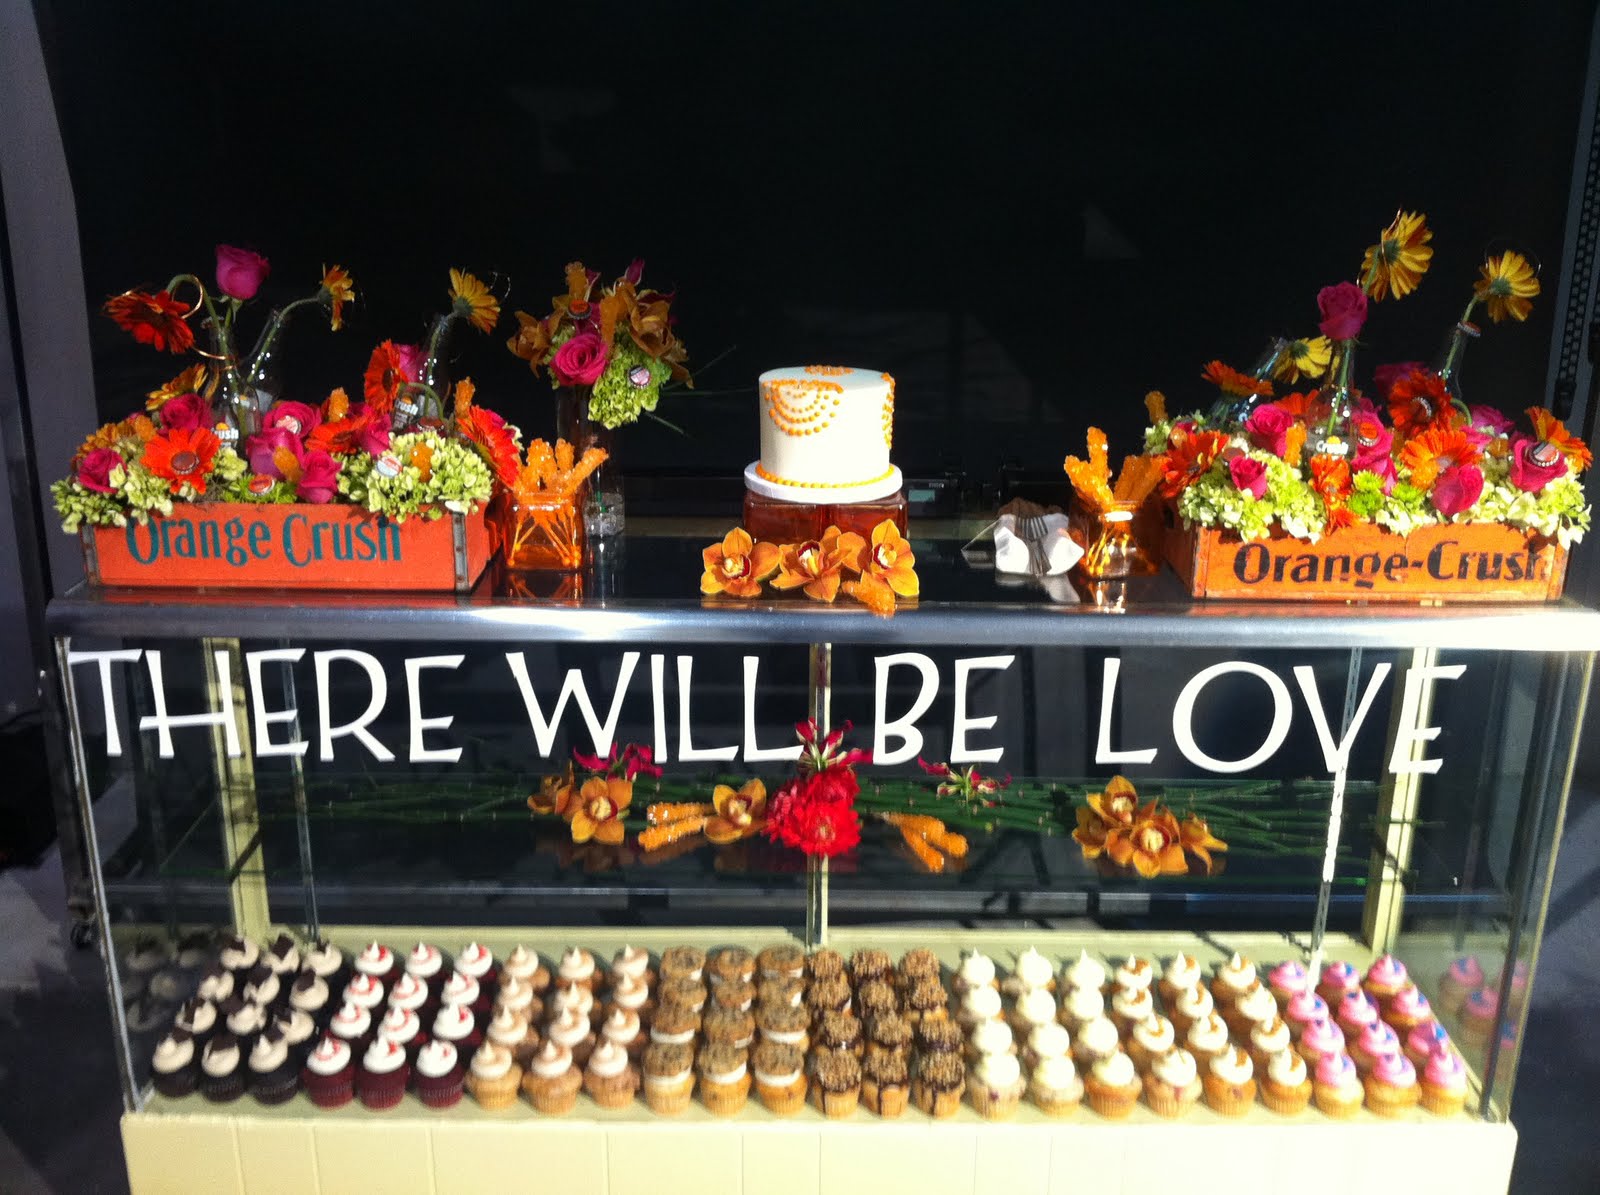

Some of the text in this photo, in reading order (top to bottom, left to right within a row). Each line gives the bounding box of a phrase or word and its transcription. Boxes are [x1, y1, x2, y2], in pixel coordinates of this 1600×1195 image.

[125, 513, 402, 568] Orange Crush
[67, 648, 1468, 775] THERE WILL BE LOVE
